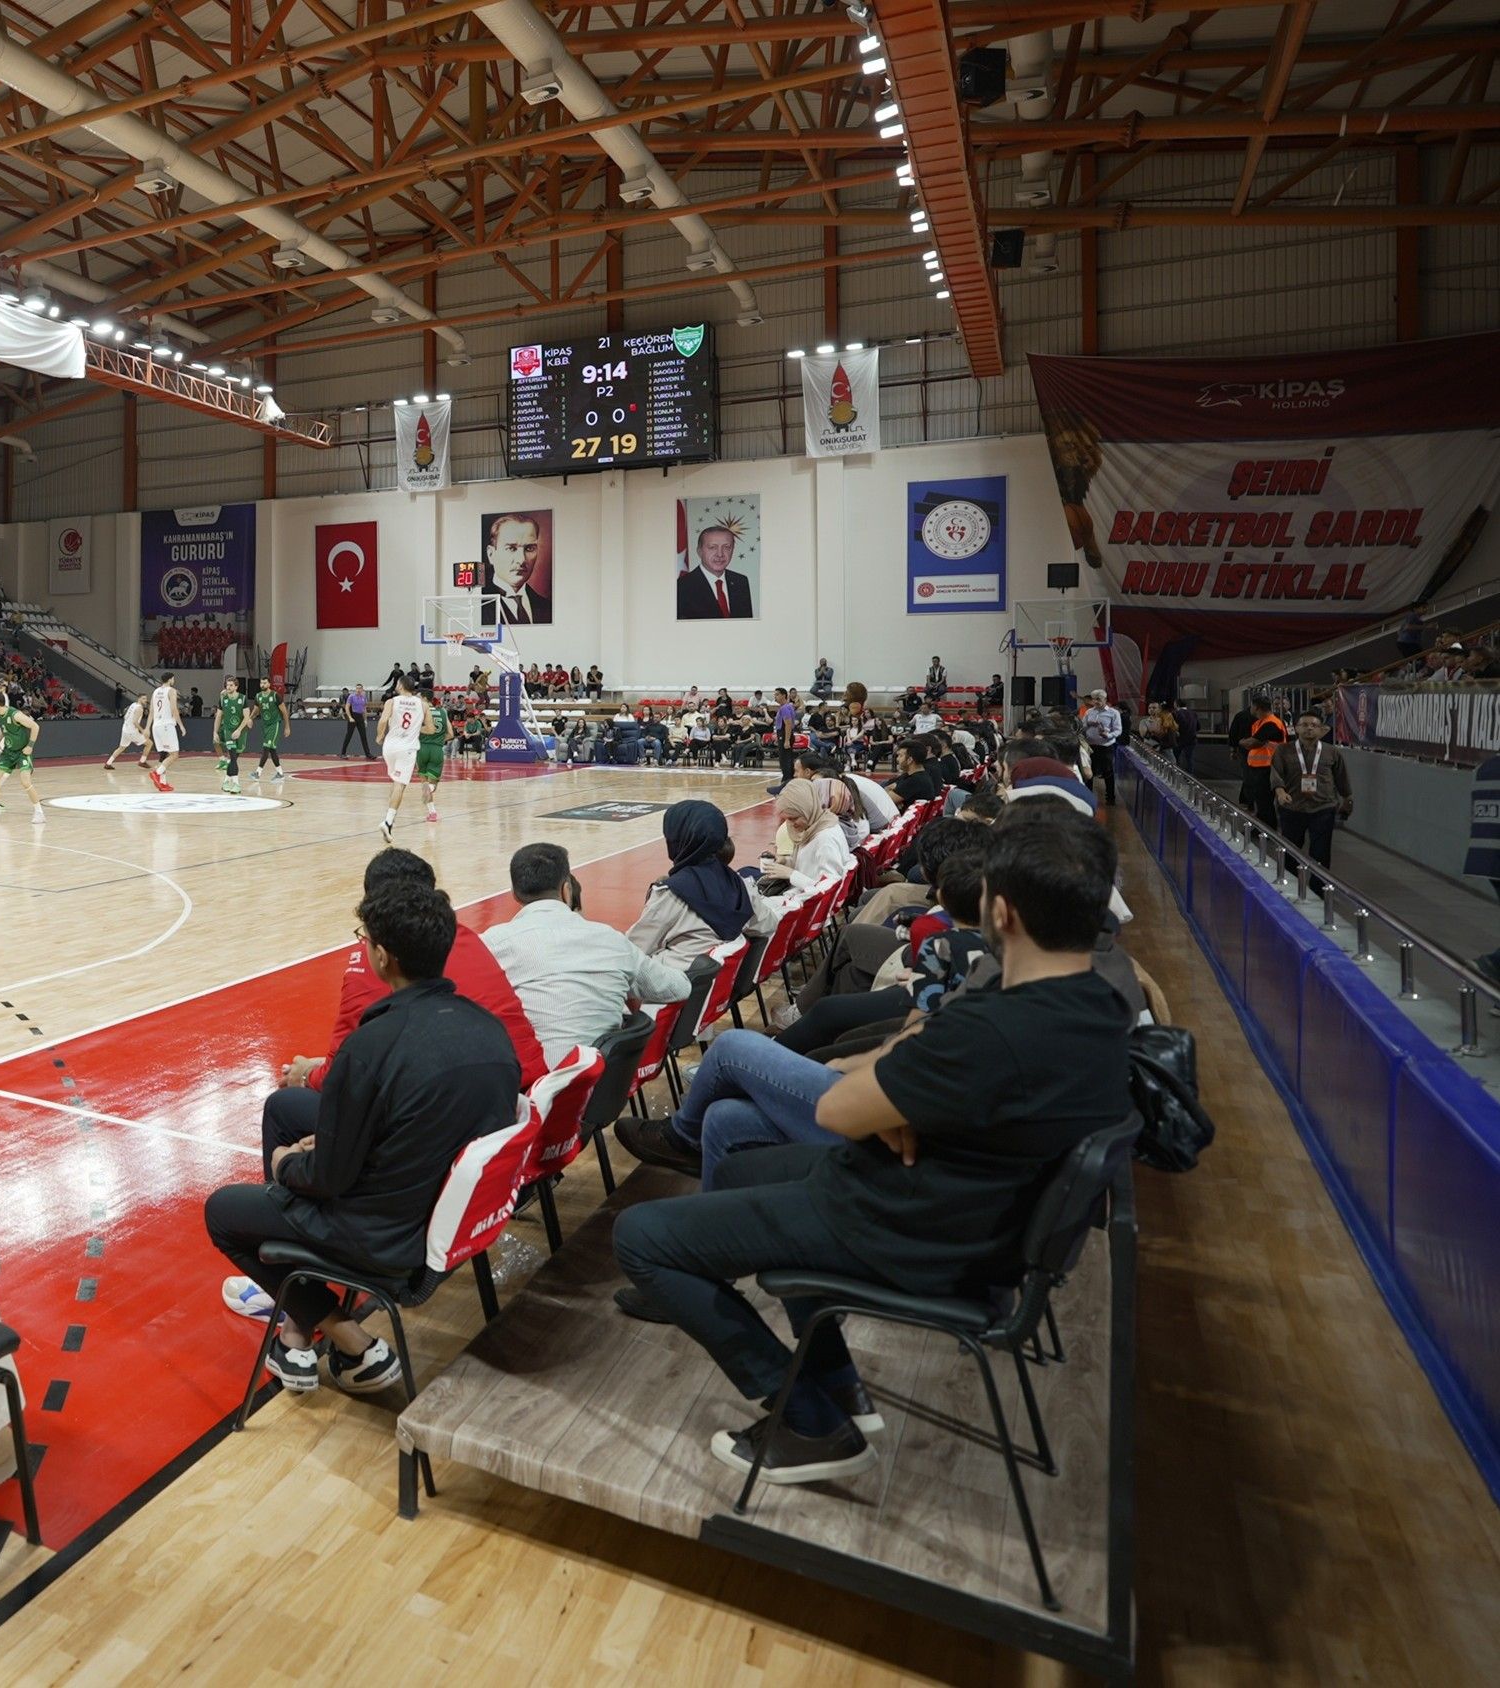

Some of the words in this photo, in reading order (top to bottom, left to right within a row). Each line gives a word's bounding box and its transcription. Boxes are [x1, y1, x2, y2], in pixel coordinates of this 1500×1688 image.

[599, 338, 610, 348] 21
[624, 334, 673, 347] KEÇİÖREN
[545, 347, 572, 358] KİPAŞ
[631, 344, 673, 356] BAĞLUM
[582, 361, 628, 384] 9:14
[597, 386, 613, 397] P2
[1259, 378, 1346, 400] KİPAŞ
[1272, 399, 1330, 409] HOLDİNG
[586, 411, 598, 426] 0
[613, 408, 625, 423] 0
[571, 437, 601, 458] 27
[610, 434, 637, 454] 19
[1227, 447, 1336, 500] ŞEHRİ
[1108, 511, 1294, 548] BASKETBOL
[171, 543, 225, 561] GURURU
[202, 566, 220, 576] KİPAŞ
[1121, 561, 1210, 596] RUHU
[1210, 552, 1369, 600] İSTİKLAL
[202, 577, 229, 585] İSTİKLAL
[458, 572, 472, 584] 20
[202, 587, 236, 596] BASKETBOL
